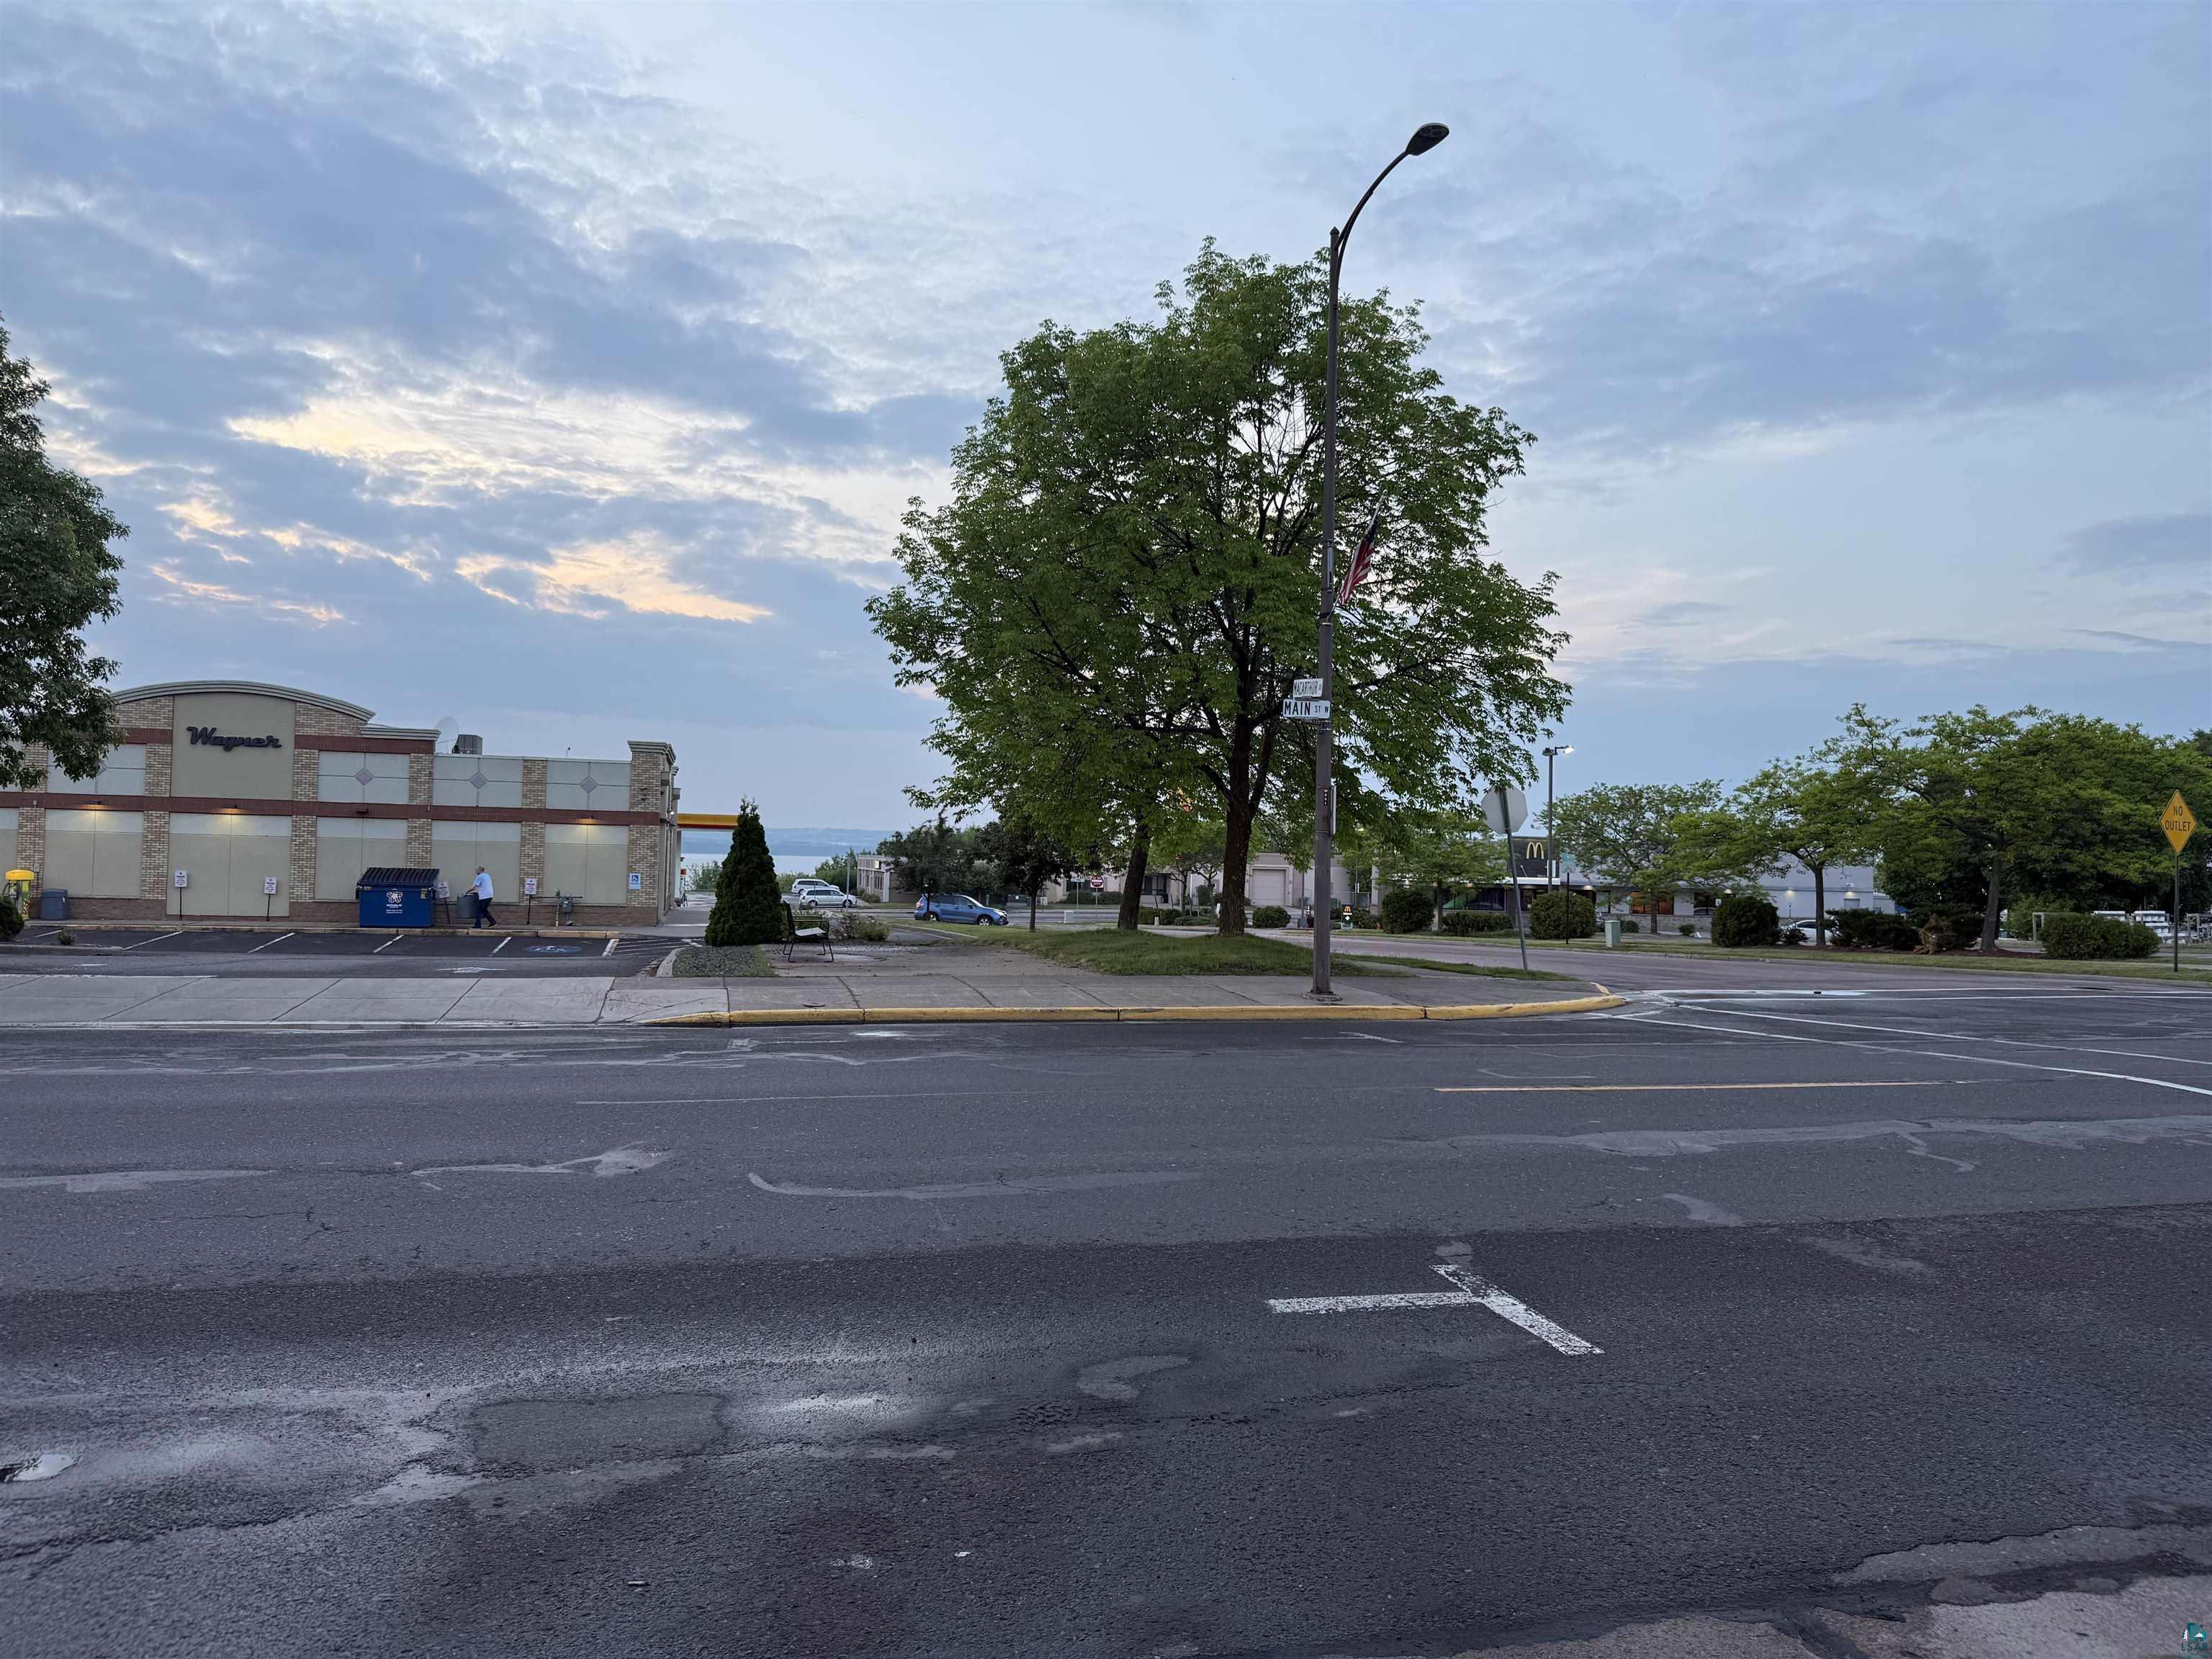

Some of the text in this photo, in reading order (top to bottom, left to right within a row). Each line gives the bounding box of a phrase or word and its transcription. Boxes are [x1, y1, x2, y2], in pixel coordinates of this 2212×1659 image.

[1284, 701, 1310, 716] MAIN
[2173, 806, 2183, 817] NO
[2164, 820, 2191, 832] OUTLET
